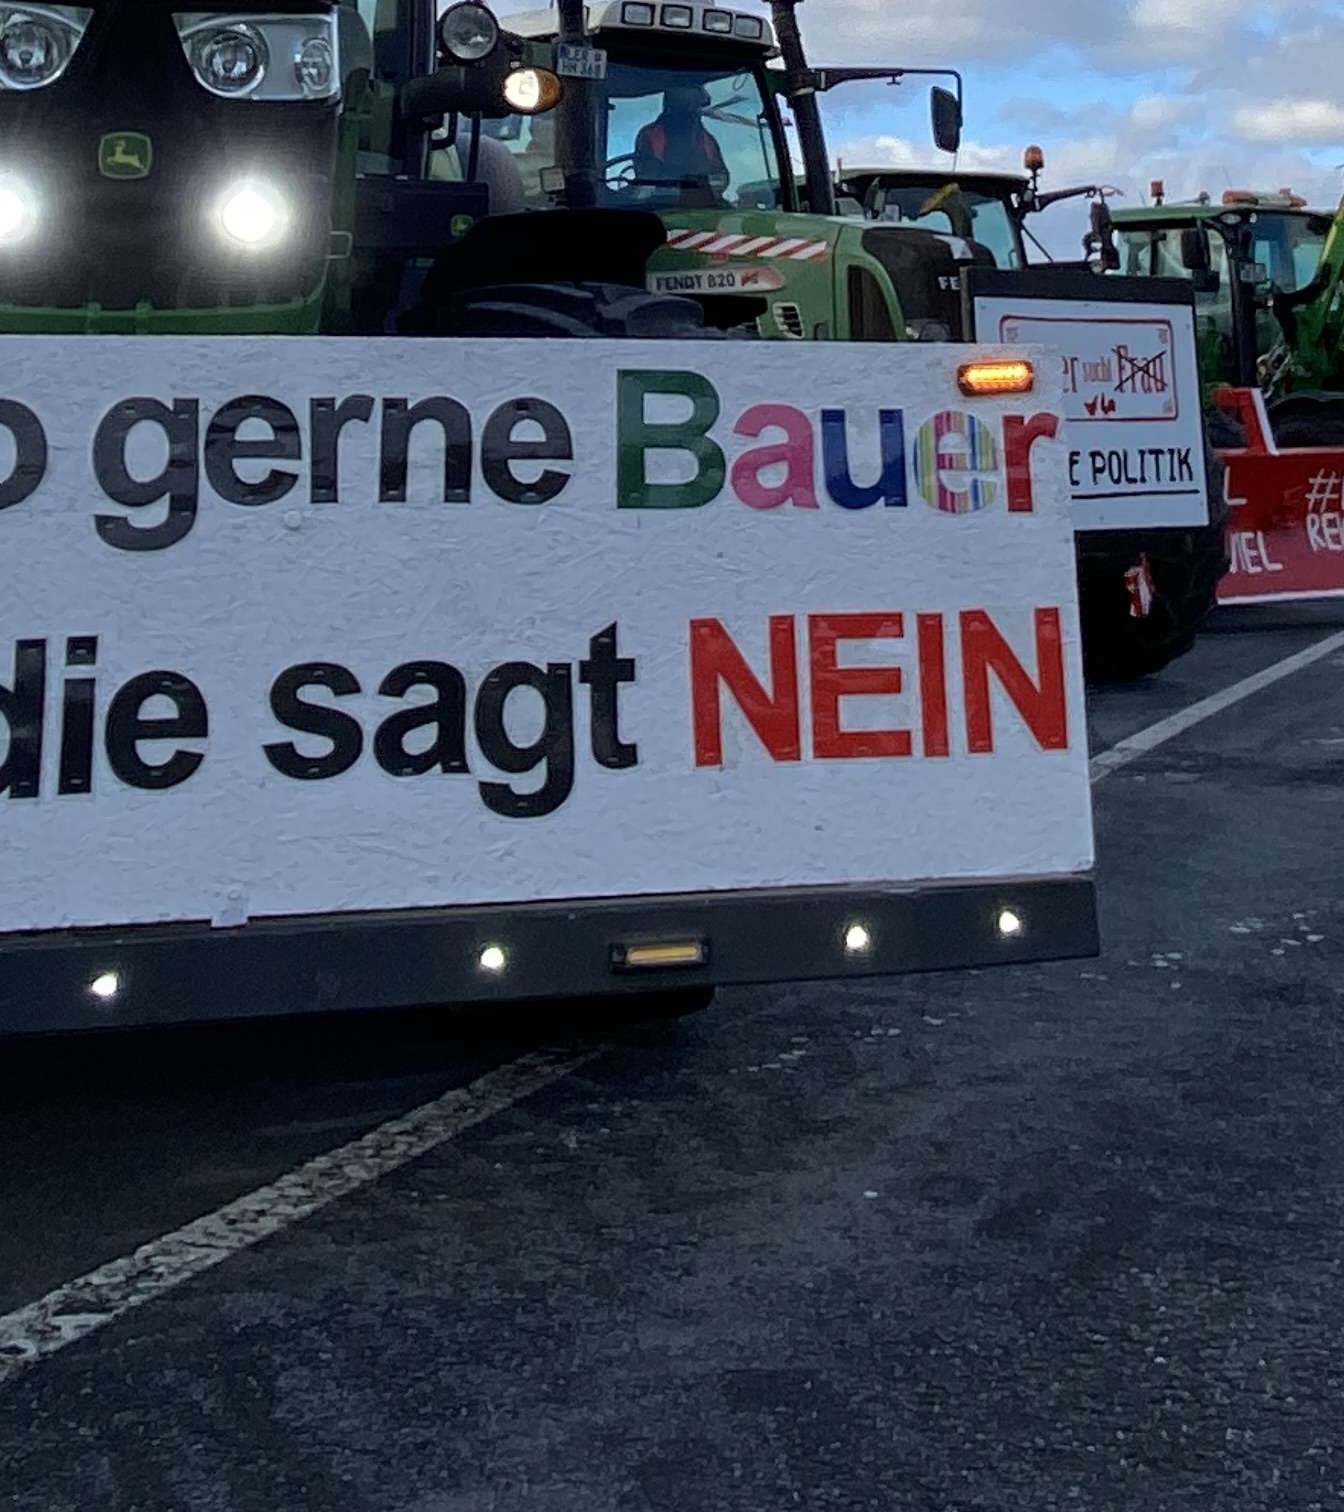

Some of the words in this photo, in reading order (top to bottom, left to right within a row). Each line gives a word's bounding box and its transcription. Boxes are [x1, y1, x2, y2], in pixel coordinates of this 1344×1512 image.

[656, 275, 702, 290] FENDT
[708, 273, 735, 288] 820
[937, 276, 960, 290] FE
[92, 393, 574, 551] gerne
[616, 368, 1058, 515] Bauer
[1089, 448, 1194, 485] POLITIK
[261, 620, 639, 818] sagt
[689, 607, 1069, 768] NEIN
